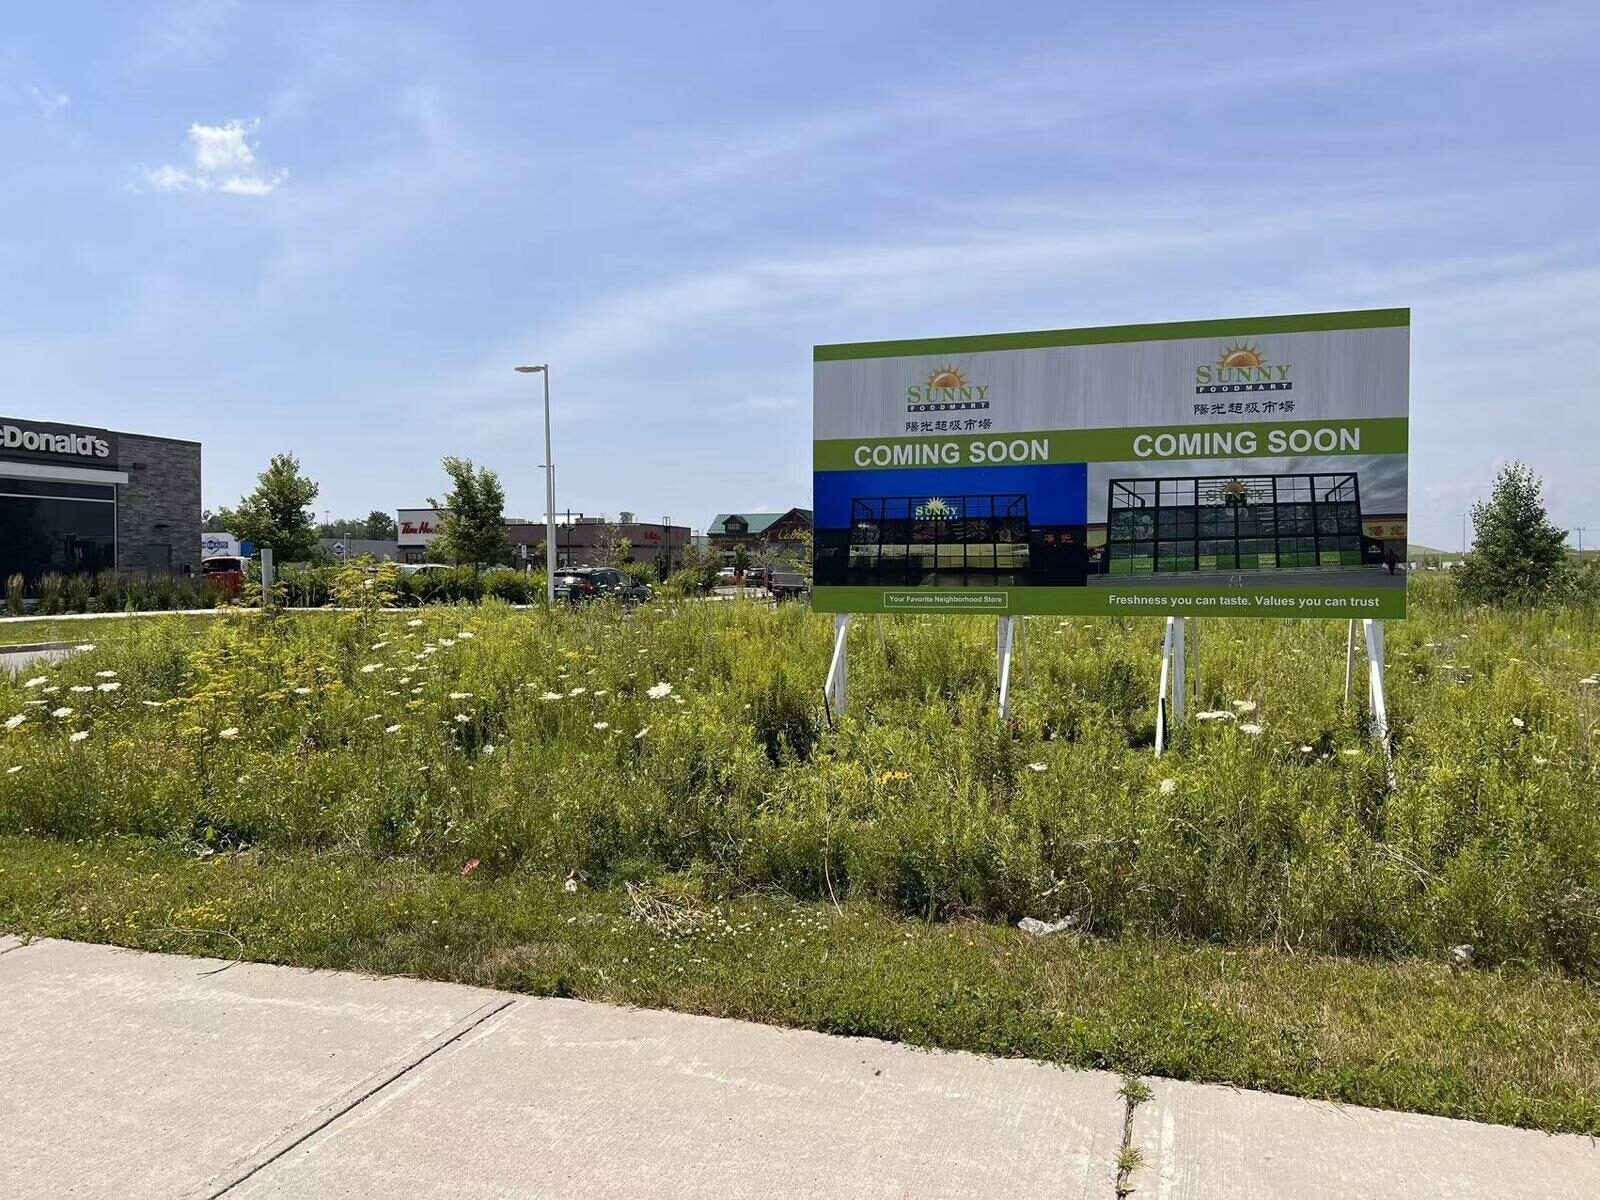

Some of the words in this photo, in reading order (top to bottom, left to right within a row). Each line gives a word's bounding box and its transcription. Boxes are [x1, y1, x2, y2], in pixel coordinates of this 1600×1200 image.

[1196, 364, 1292, 385] SUNNY
[907, 384, 989, 403] SUNNY
[1199, 383, 1288, 393] FOODMART
[910, 402, 987, 412] FOODMART
[1193, 400, 1296, 416] 陽光超級市場
[905, 418, 993, 432] 陽光超級市場
[0, 424, 110, 458] Donald's
[1133, 431, 1257, 457] COMING
[1267, 427, 1360, 453] SOON
[854, 442, 960, 467] COMING
[968, 438, 1049, 463] SOON
[915, 505, 958, 516] SUNNY
[400, 521, 418, 534] Tim
[889, 595, 905, 603] Your
[906, 595, 933, 603] Favorite
[934, 595, 982, 604] Neighborhood
[983, 595, 1002, 603] Store
[1108, 594, 1168, 605] Freshness
[1170, 596, 1192, 607] you
[1195, 597, 1216, 605] can
[1220, 596, 1252, 606] taste.
[1255, 595, 1296, 606] Values
[1298, 597, 1321, 608] you
[1324, 597, 1347, 607] can
[1350, 596, 1380, 607] trust
